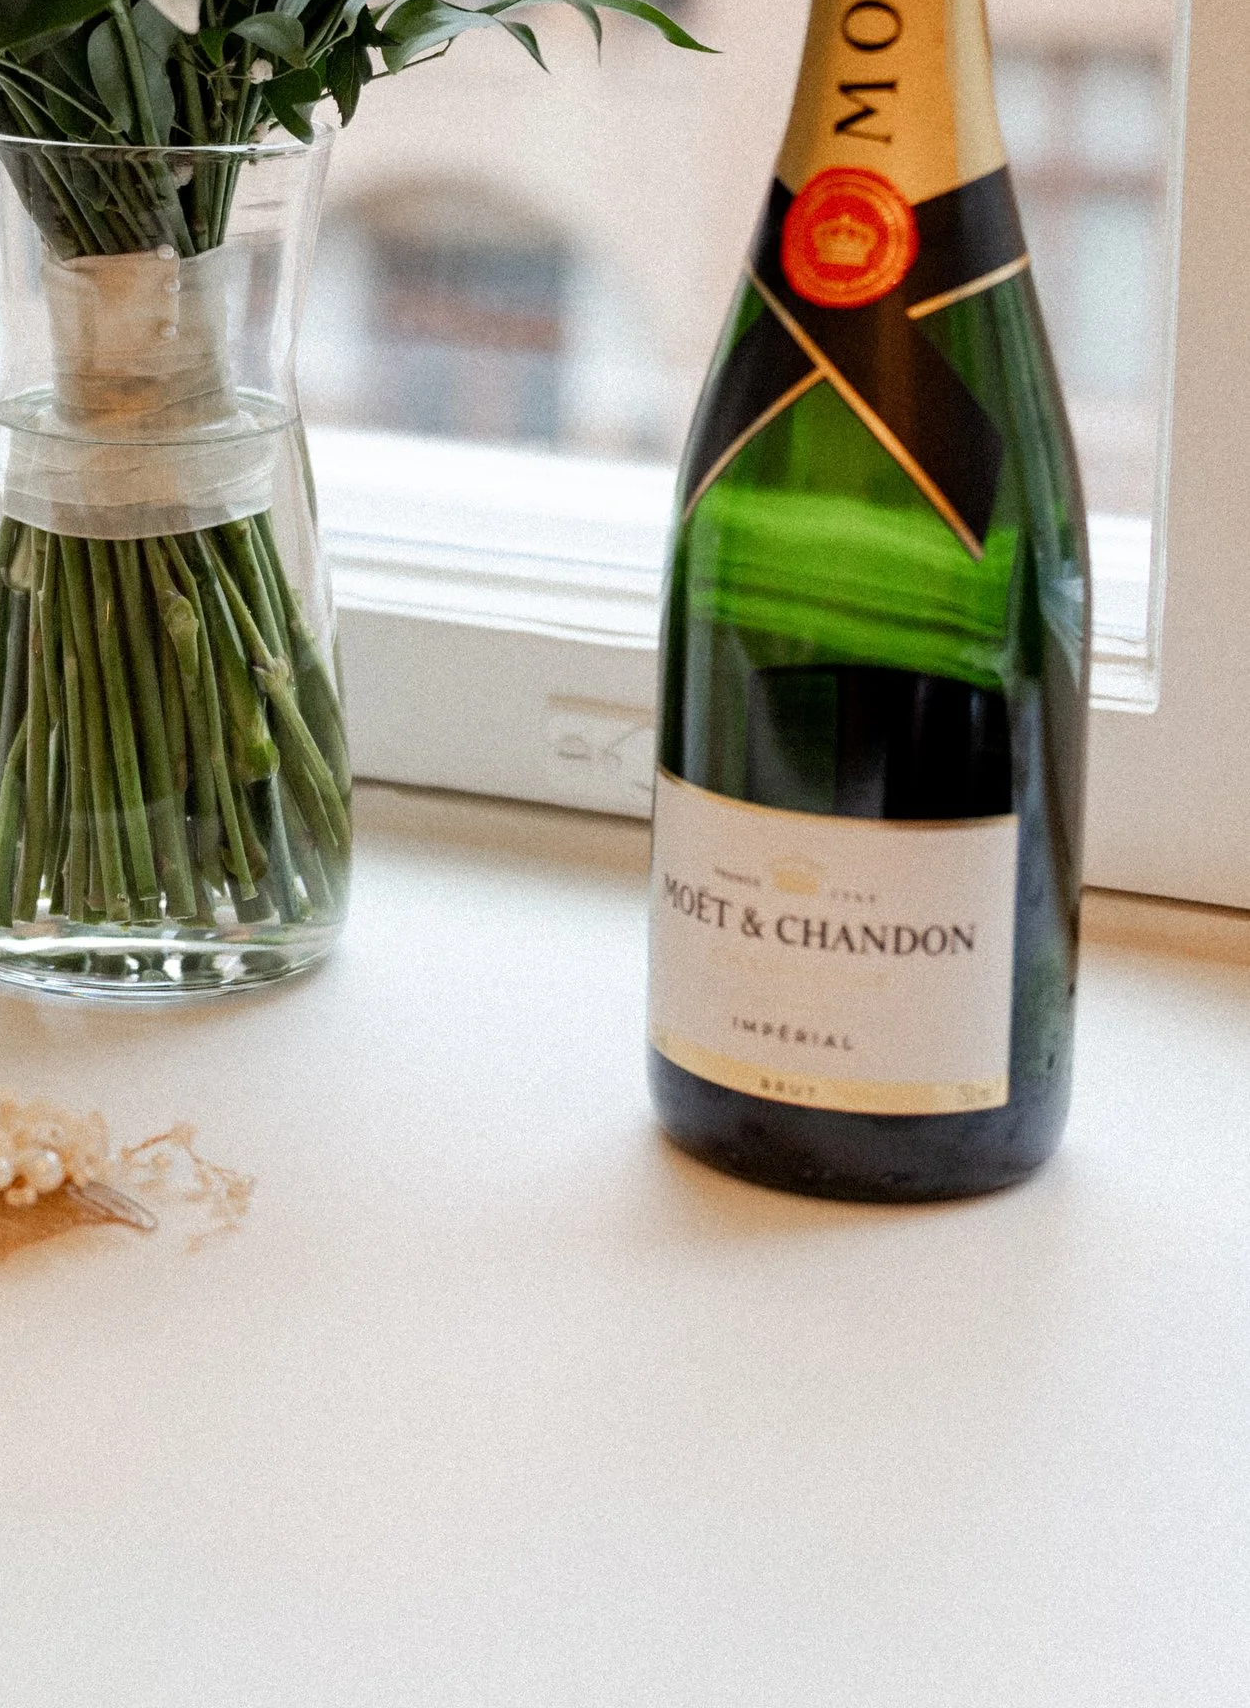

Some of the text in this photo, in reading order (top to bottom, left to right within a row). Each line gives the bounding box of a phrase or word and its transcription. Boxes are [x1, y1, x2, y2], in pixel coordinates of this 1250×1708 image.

[662, 872, 734, 928] MOËT
[741, 905, 764, 941] &
[775, 912, 976, 958] CHANDON
